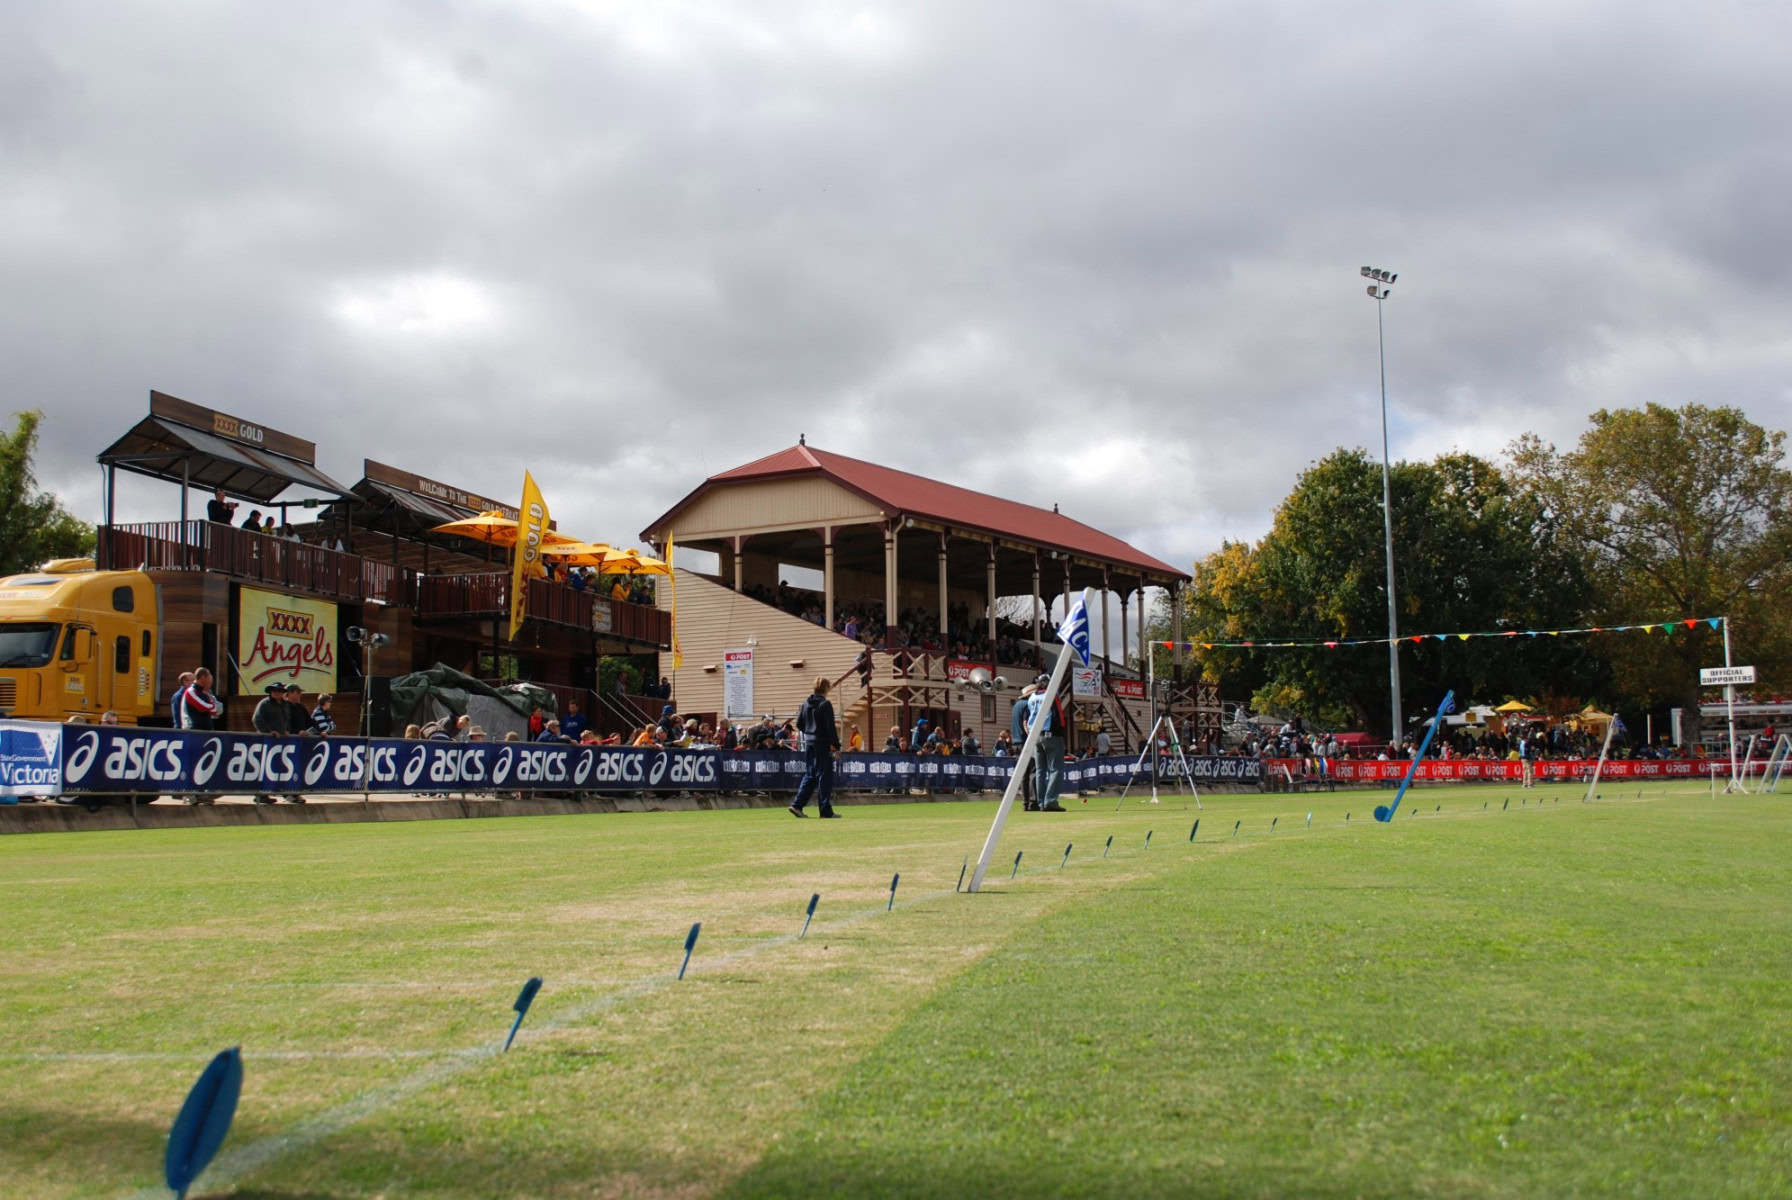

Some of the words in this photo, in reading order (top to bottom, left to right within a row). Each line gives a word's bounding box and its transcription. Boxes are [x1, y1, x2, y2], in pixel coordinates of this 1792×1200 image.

[215, 417, 238, 433] XXXX
[240, 424, 263, 442] GOLD
[524, 502, 544, 562] GOLD
[271, 611, 311, 635] XXXX
[242, 626, 333, 677] Angels
[955, 668, 969, 677] POST
[1702, 675, 1753, 684] SUPPORTERS
[104, 737, 184, 781] asics
[227, 742, 296, 782] asics
[334, 744, 397, 782] asics
[430, 748, 486, 782] asics
[516, 750, 567, 782] asics
[596, 752, 644, 782] asics
[1195, 759, 1212, 776] asics
[1220, 759, 1236, 776] asics
[1, 763, 59, 784] Victoria
[670, 754, 715, 782] asics
[1245, 760, 1260, 776] asics
[1340, 766, 1353, 777] POST
[1363, 766, 1377, 777] POST
[1387, 766, 1400, 777] POST
[1440, 766, 1453, 776] POST
[1464, 766, 1479, 776] POST
[1491, 766, 1507, 775] POST
[1549, 766, 1566, 775] POST
[1609, 765, 1627, 774] POST
[1641, 765, 1659, 774] POST
[1673, 764, 1691, 773] POST
